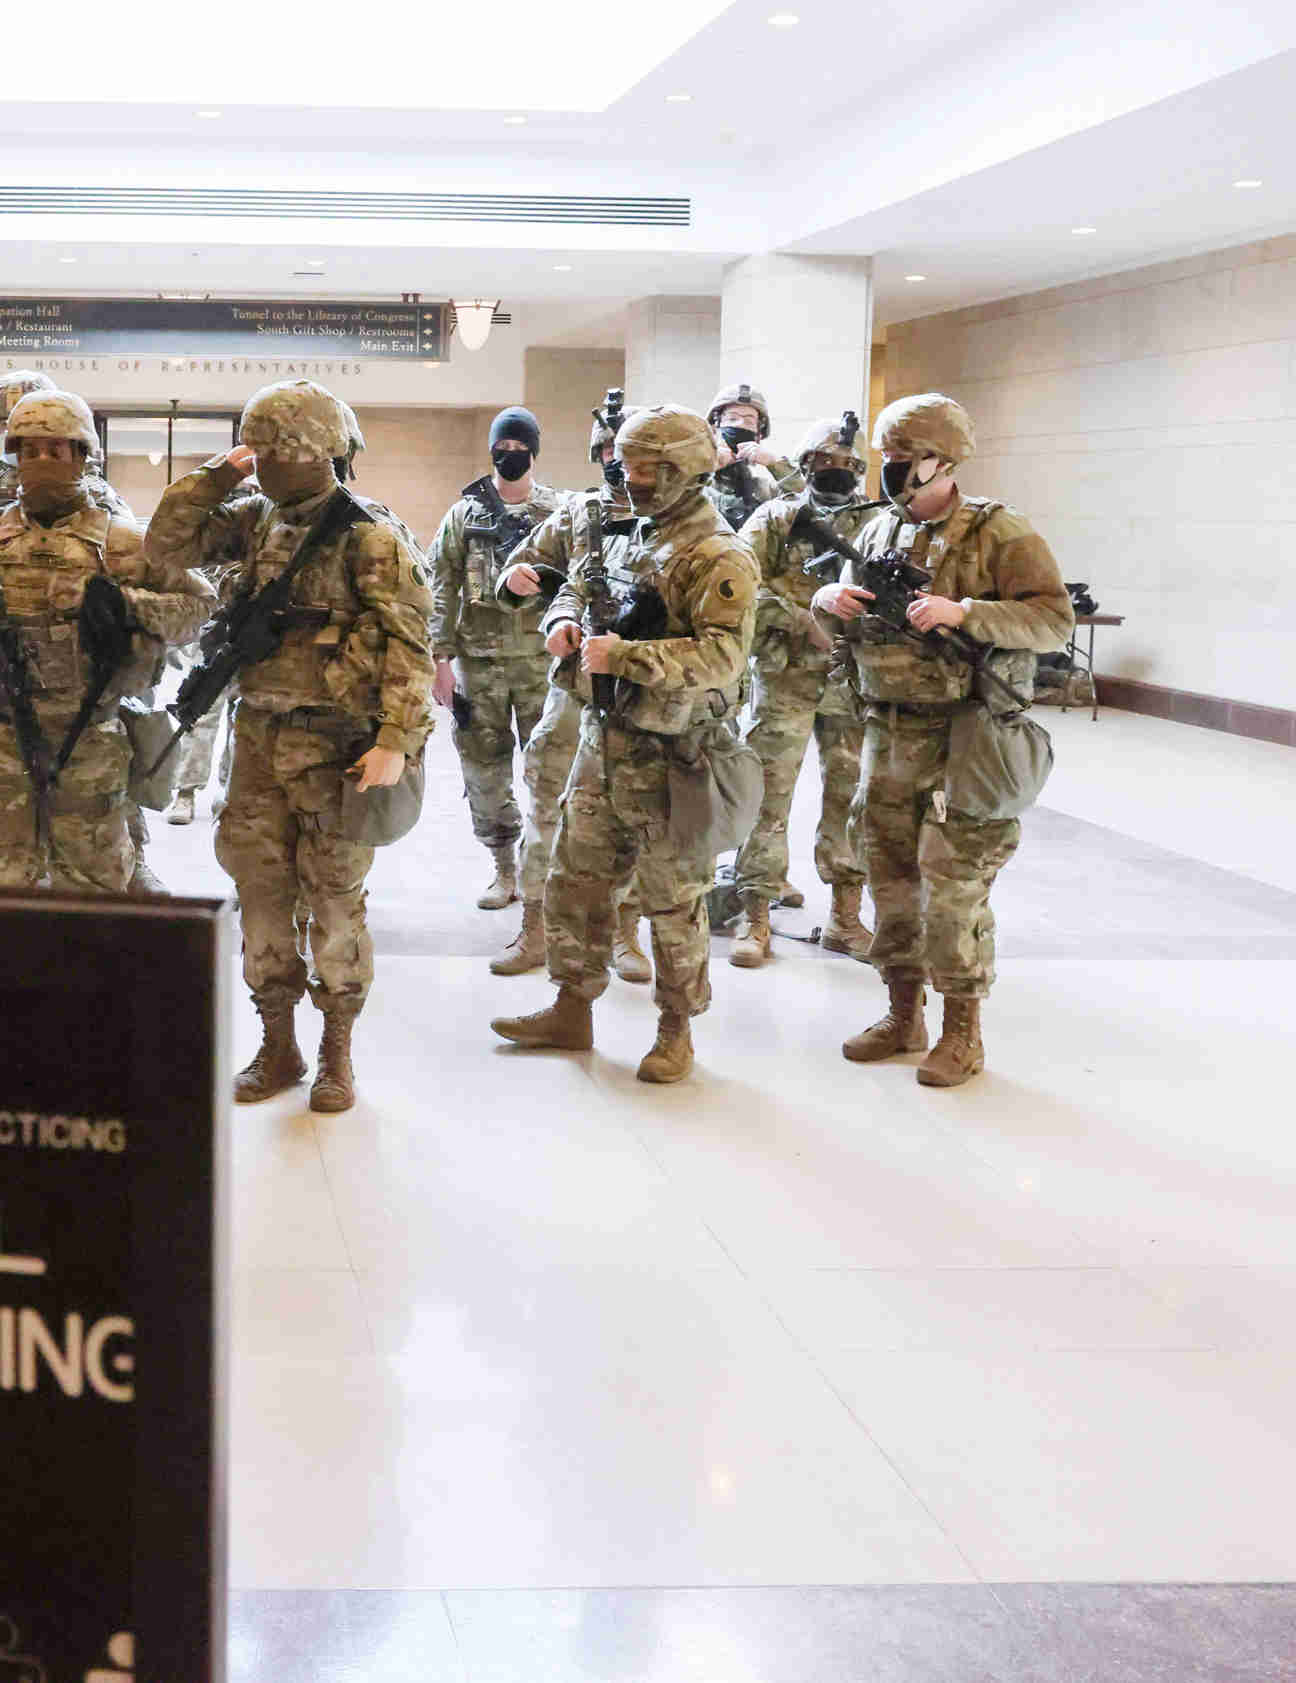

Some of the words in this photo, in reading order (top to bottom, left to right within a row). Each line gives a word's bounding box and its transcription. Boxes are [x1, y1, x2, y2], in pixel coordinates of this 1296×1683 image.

[36, 305, 60, 317] Hall
[231, 308, 270, 320] Tunnel
[273, 310, 284, 320] to
[287, 309, 304, 320] the
[307, 309, 347, 323] Library
[351, 310, 362, 321] of
[365, 310, 415, 323] Congress
[16, 321, 73, 332] Restaurant
[256, 325, 289, 336] South
[293, 325, 315, 336] Gift
[319, 326, 345, 338] Shop
[359, 327, 415, 338] Restrooms
[44, 337, 80, 347] Rooms
[360, 340, 387, 352] Main
[391, 341, 413, 352] Exit
[35, 360, 100, 371] HOUSE
[118, 361, 141, 371] OF
